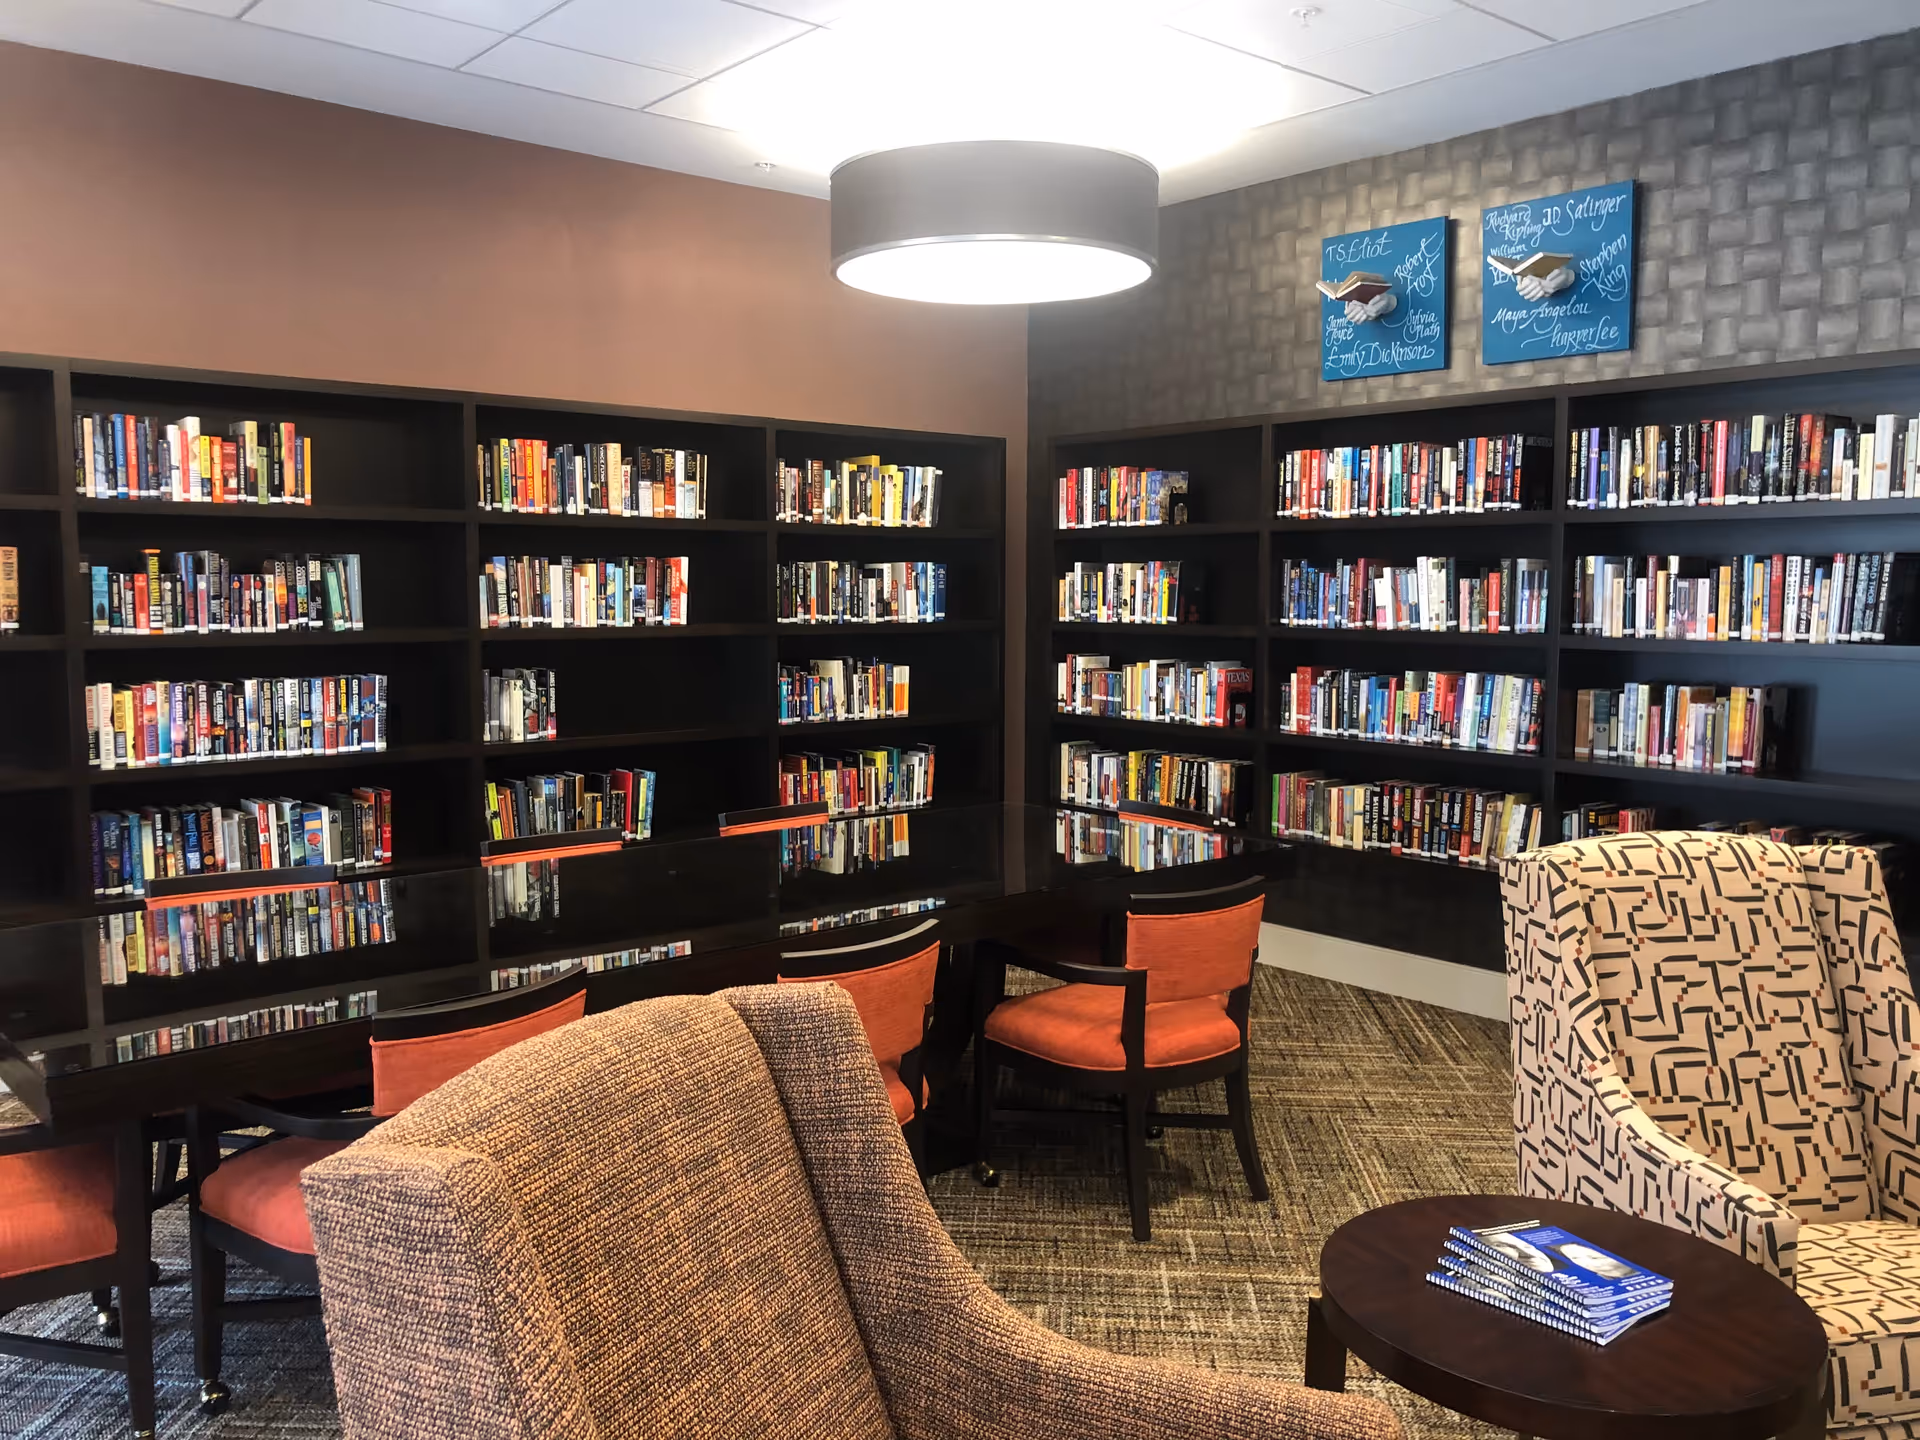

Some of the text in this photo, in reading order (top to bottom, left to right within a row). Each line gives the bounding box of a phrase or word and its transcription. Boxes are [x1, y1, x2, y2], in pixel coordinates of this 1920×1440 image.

[1485, 204, 1531, 233] Rudyard
[1551, 195, 1626, 236] Salinger
[1341, 231, 1392, 268] Eliot
[1490, 244, 1527, 257] William
[1499, 221, 1545, 247] Kipling
[1394, 232, 1444, 284] Robert
[1580, 233, 1627, 281] Stephen
[1582, 264, 1628, 301] King
[1407, 309, 1437, 334] Sylvia
[1491, 295, 1592, 334] Maya Angelou
[1325, 328, 1354, 347] Joyce
[1403, 322, 1440, 343] Plath
[1586, 315, 1621, 350] Lee
[1325, 340, 1366, 377] Emily
[1674, 425, 1682, 446] Daniel
[149, 556, 160, 578] PATRICIA
[1867, 555, 1879, 604] BRAD THOR
[1879, 563, 1890, 601] BRAD THOR
[150, 579, 159, 605] CORNWELL
[1226, 672, 1250, 685] TEXAS
[198, 685, 207, 727] CLIVE CUSSLER
[215, 690, 224, 725] CLIVE CUSSLER
[264, 700, 272, 725] CUSSLER
[290, 700, 299, 726] CUSSLER
[1473, 794, 1483, 842] JOHN SANDFORD
